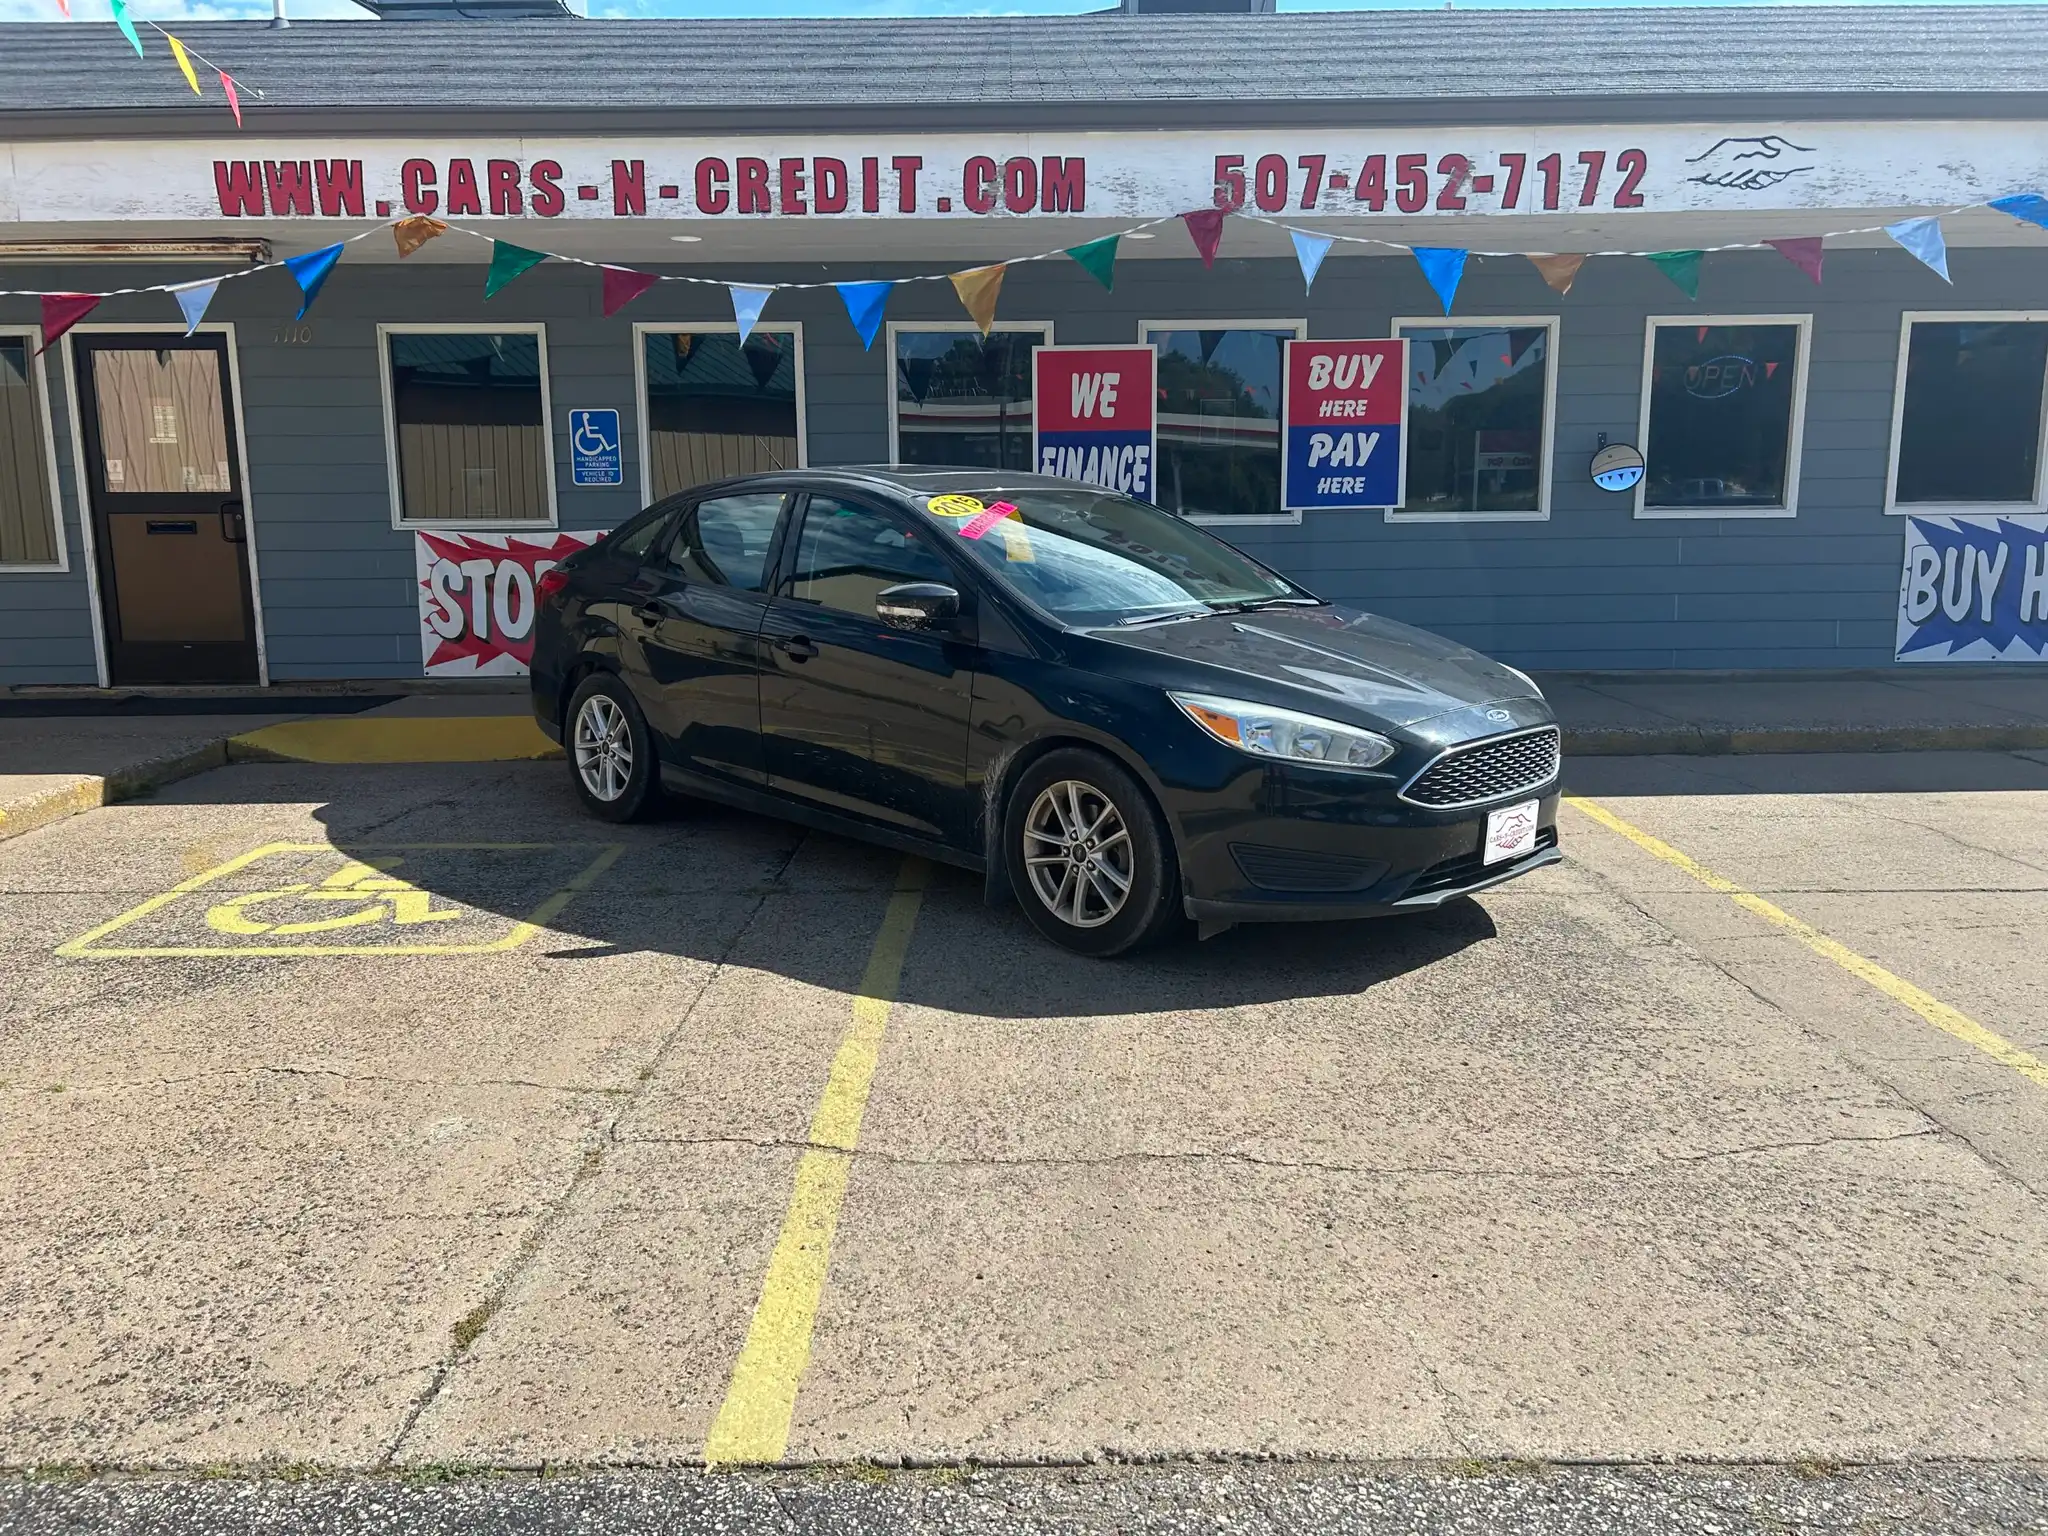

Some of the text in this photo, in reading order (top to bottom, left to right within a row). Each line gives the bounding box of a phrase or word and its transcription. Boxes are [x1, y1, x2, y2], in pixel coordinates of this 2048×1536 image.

[213, 156, 1086, 217] WWW.CARS-N-CREDIT.COM
[1214, 148, 1647, 212] 507-452-7172
[1308, 354, 1384, 390] BUY
[1684, 364, 1758, 390] OPEN
[1072, 373, 1120, 418] WE
[1319, 400, 1368, 418] HERE
[1308, 432, 1380, 467] PAY
[1041, 445, 1149, 493] FINANCE
[1317, 477, 1366, 495] HERE
[933, 496, 981, 515] 2015
[1906, 541, 2009, 625] BUY
